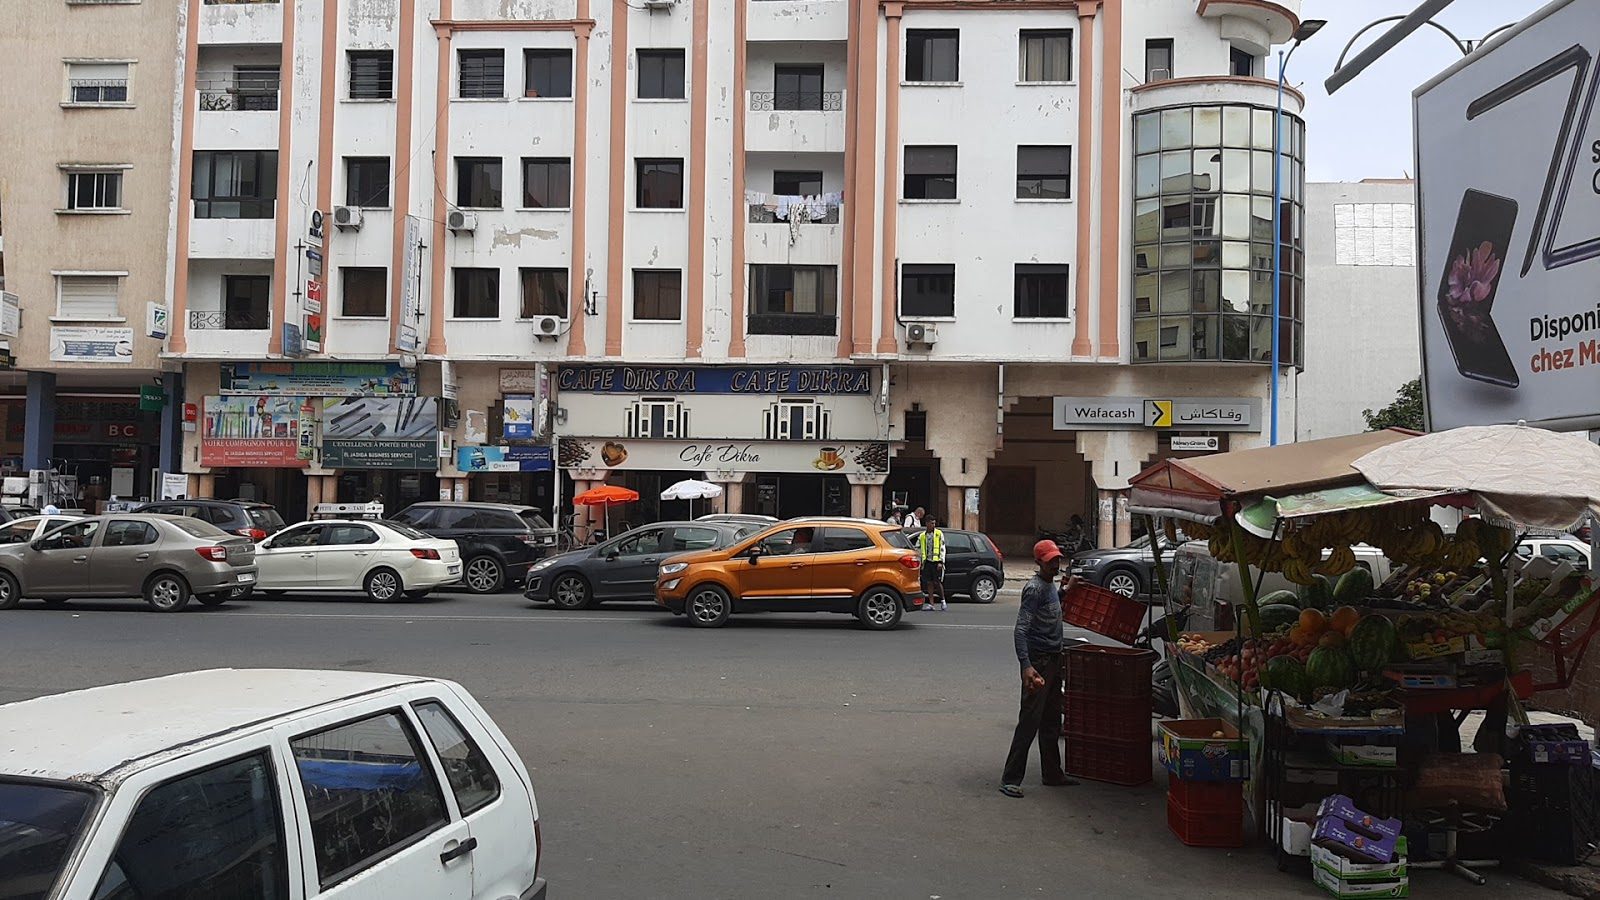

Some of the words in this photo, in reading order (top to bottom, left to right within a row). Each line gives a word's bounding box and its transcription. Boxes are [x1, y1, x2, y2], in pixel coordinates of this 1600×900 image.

[1531, 347, 1574, 373] chez
[559, 367, 615, 390] CAFE
[623, 367, 696, 391] DIKRA
[730, 368, 791, 392] CAFE
[797, 368, 870, 393] DIKRA
[1074, 407, 1135, 418] Wafacash
[1180, 408, 1242, 421] وفاكاش
[679, 444, 714, 467] Café
[716, 444, 760, 463] Dikra
